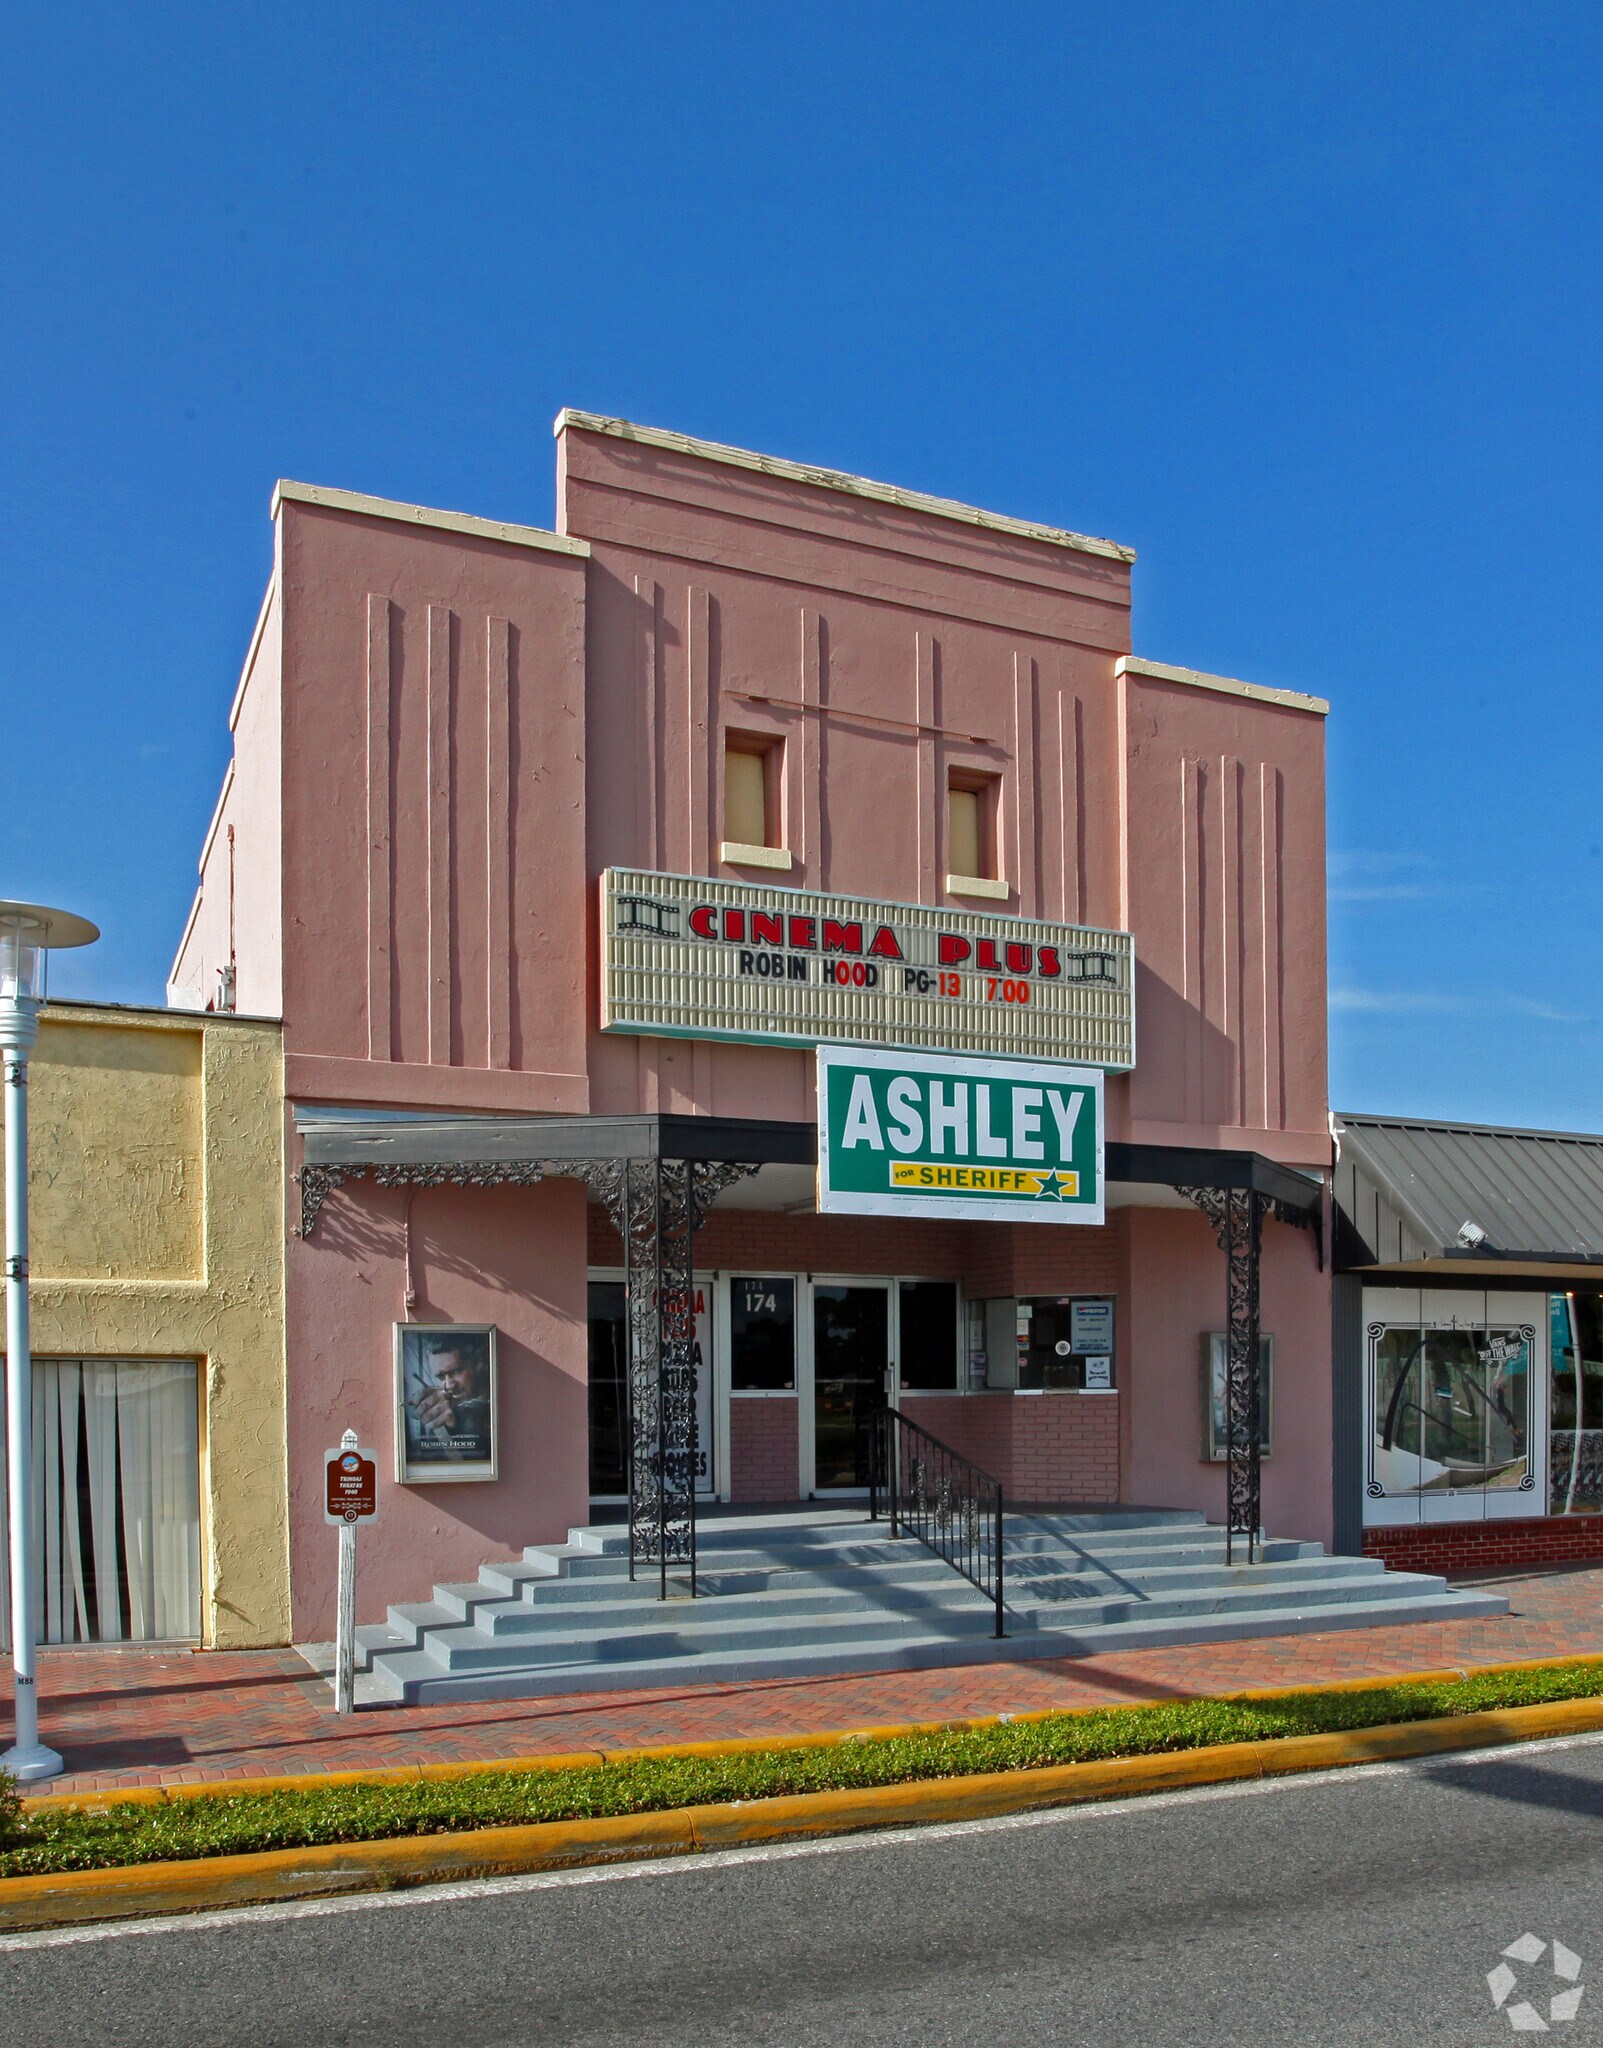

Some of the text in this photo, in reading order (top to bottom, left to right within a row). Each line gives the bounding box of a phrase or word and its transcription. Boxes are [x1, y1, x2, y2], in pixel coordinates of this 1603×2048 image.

[689, 905, 1061, 978] CINEMA PLUS
[740, 950, 806, 980] ROBIN
[823, 959, 877, 987] HOOD
[904, 968, 961, 997] PG-13
[841, 1074, 1085, 1162] ASHLEY
[895, 1167, 1027, 1189] FOR SHERIFF
[745, 1294, 776, 1312] 174
[1489, 1336, 1506, 1348] VANS
